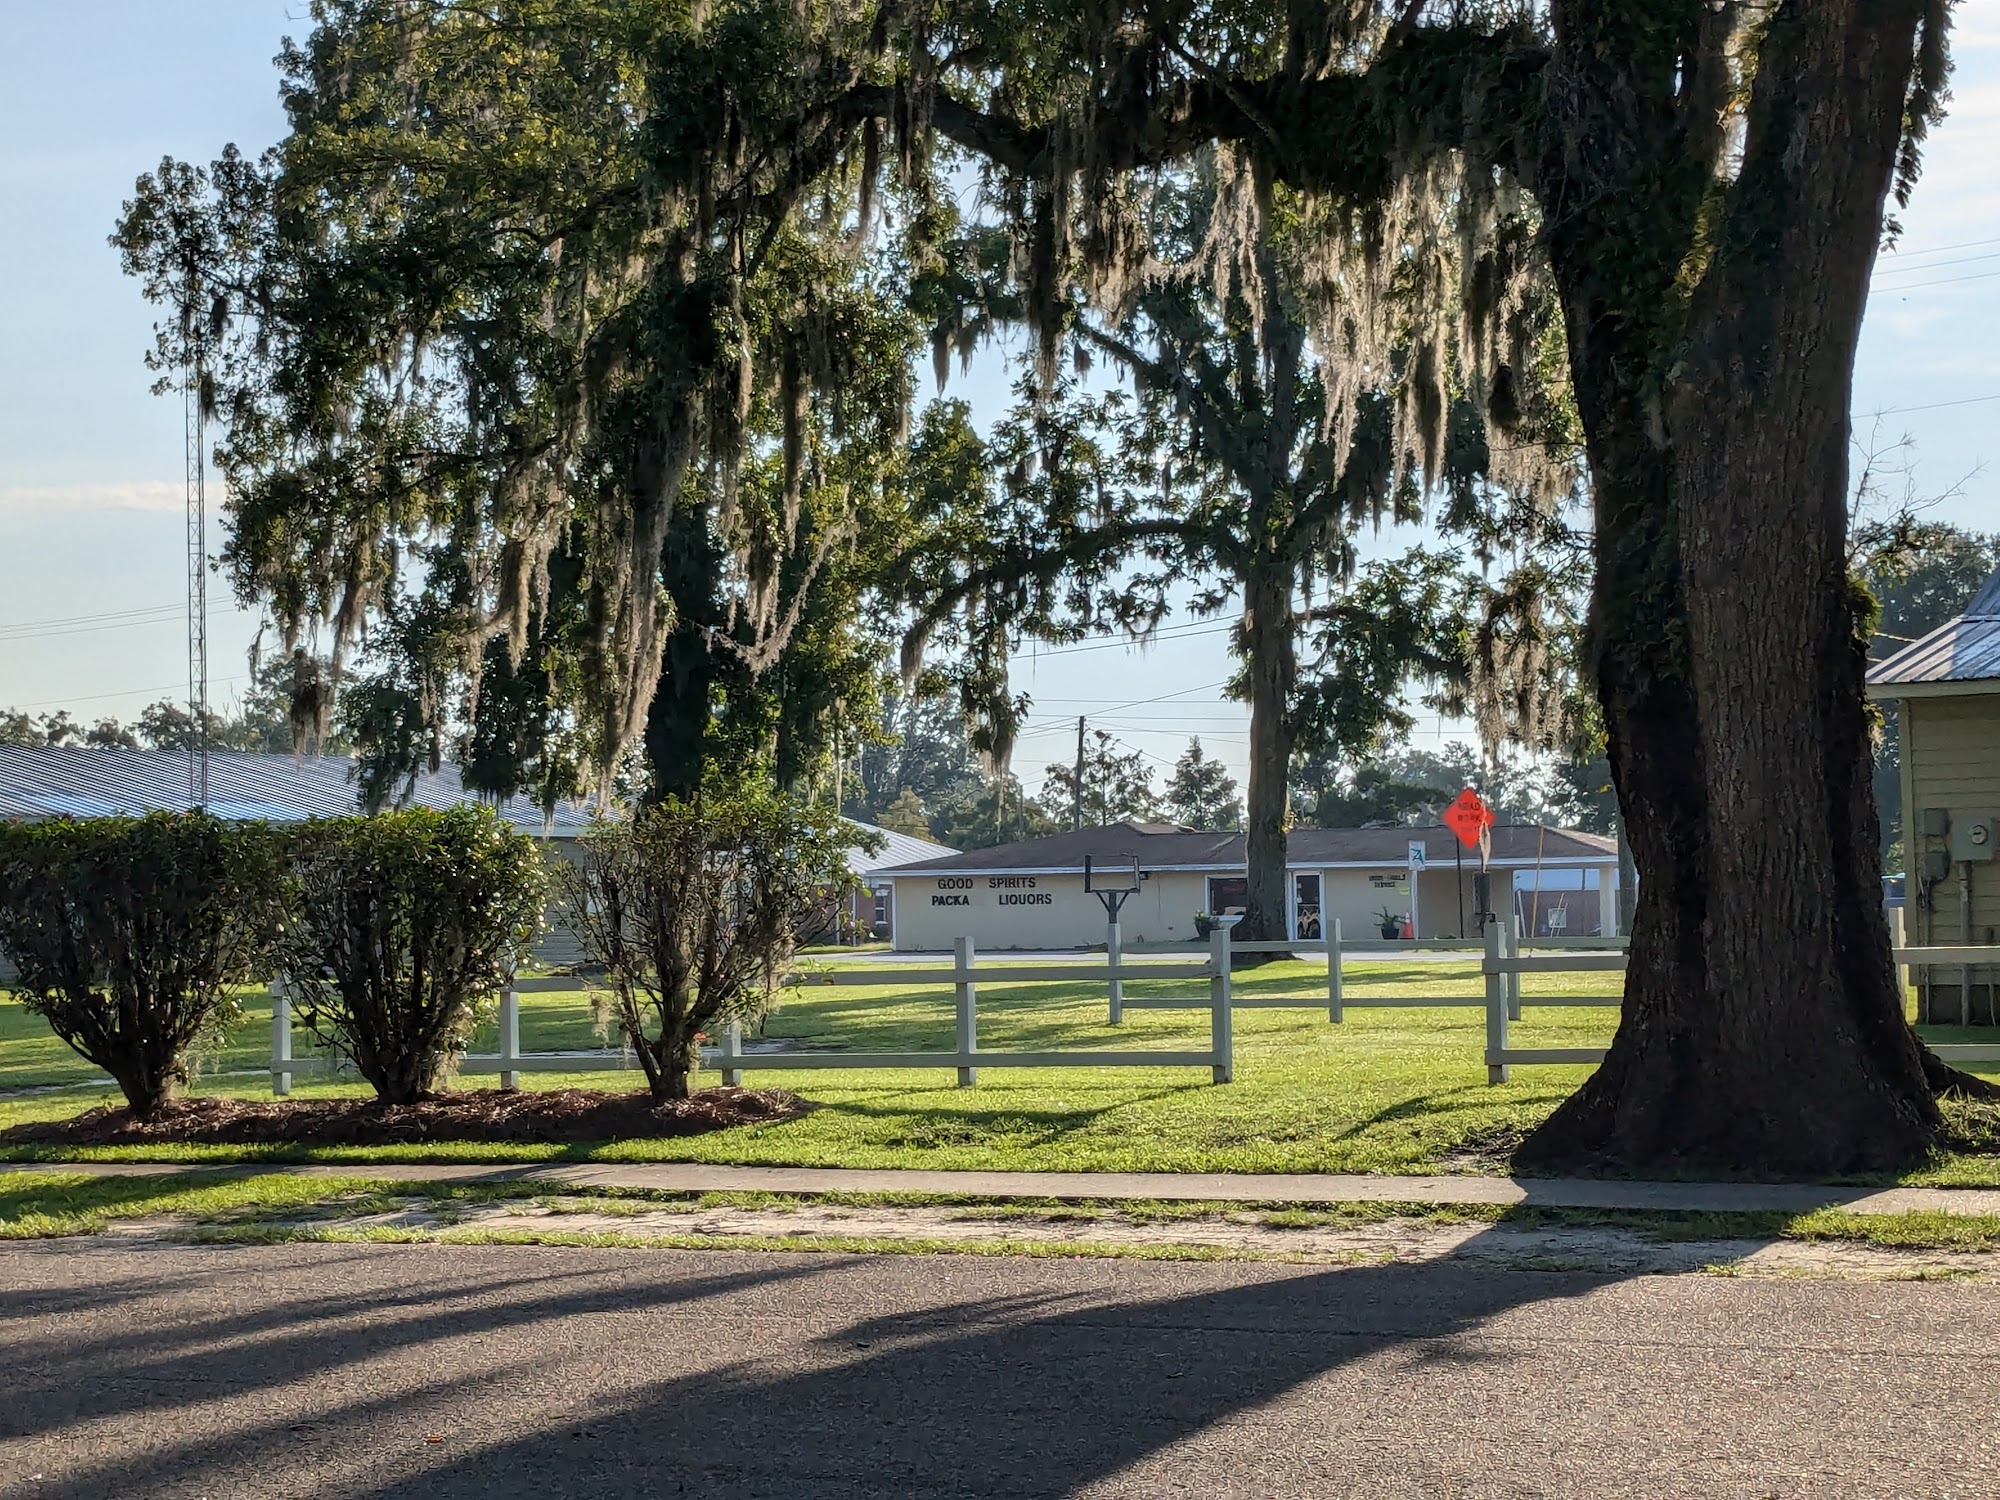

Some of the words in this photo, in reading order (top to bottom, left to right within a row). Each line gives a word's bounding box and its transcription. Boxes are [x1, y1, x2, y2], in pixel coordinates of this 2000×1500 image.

[937, 878, 974, 890] GOOD
[988, 876, 1036, 889] SPIRITS
[931, 895, 970, 906] PACKA
[998, 893, 1053, 906] LIQUORS
